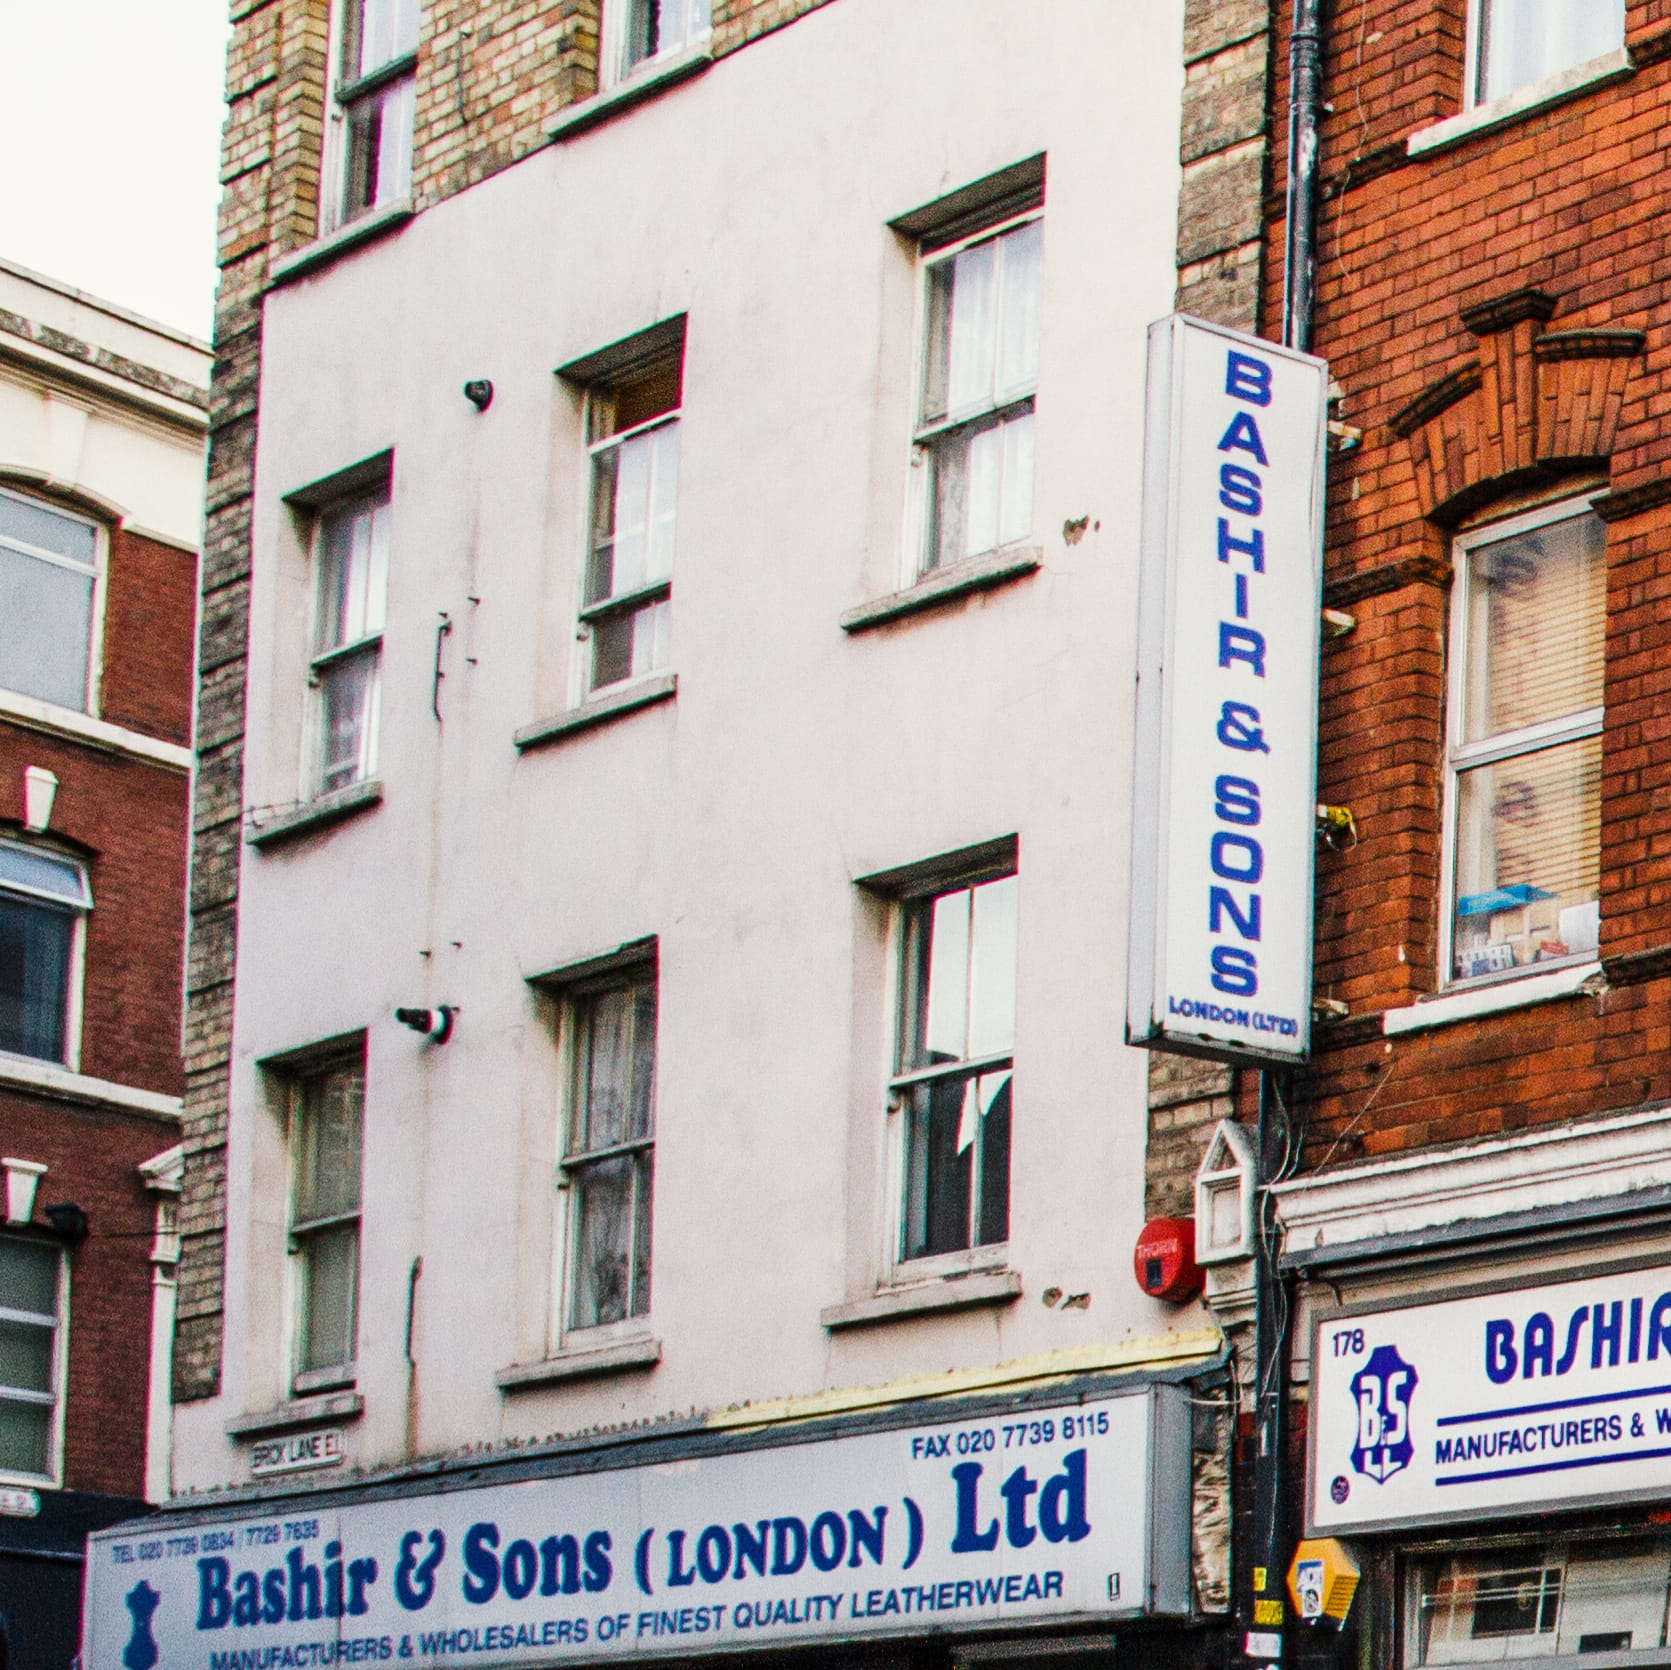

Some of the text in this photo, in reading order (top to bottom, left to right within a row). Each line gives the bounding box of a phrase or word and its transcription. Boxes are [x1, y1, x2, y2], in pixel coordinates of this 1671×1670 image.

[1209, 350, 1272, 998] BASHIR & SONS
[1168, 995, 1298, 1038] LONDON (LTD)
[1331, 1328, 1365, 1357] 178
[912, 1412, 1109, 1459] FAX 020 7739 8115
[1434, 1413, 1623, 1466] MANUFACTURERS
[1630, 1411, 1645, 1438] &
[112, 1543, 133, 1564] TEL
[196, 1541, 378, 1630] Bashir
[395, 1530, 446, 1610] &
[462, 1523, 612, 1604] Sons
[950, 1448, 1091, 1553] Ltd
[398, 1636, 414, 1659] &
[419, 1615, 588, 1656] WHOLESALERS
[596, 1612, 631, 1641] OF
[637, 1602, 726, 1638] FINEST
[734, 1593, 843, 1628] QUALITY
[851, 1570, 1064, 1620] LEATHERWEAR
